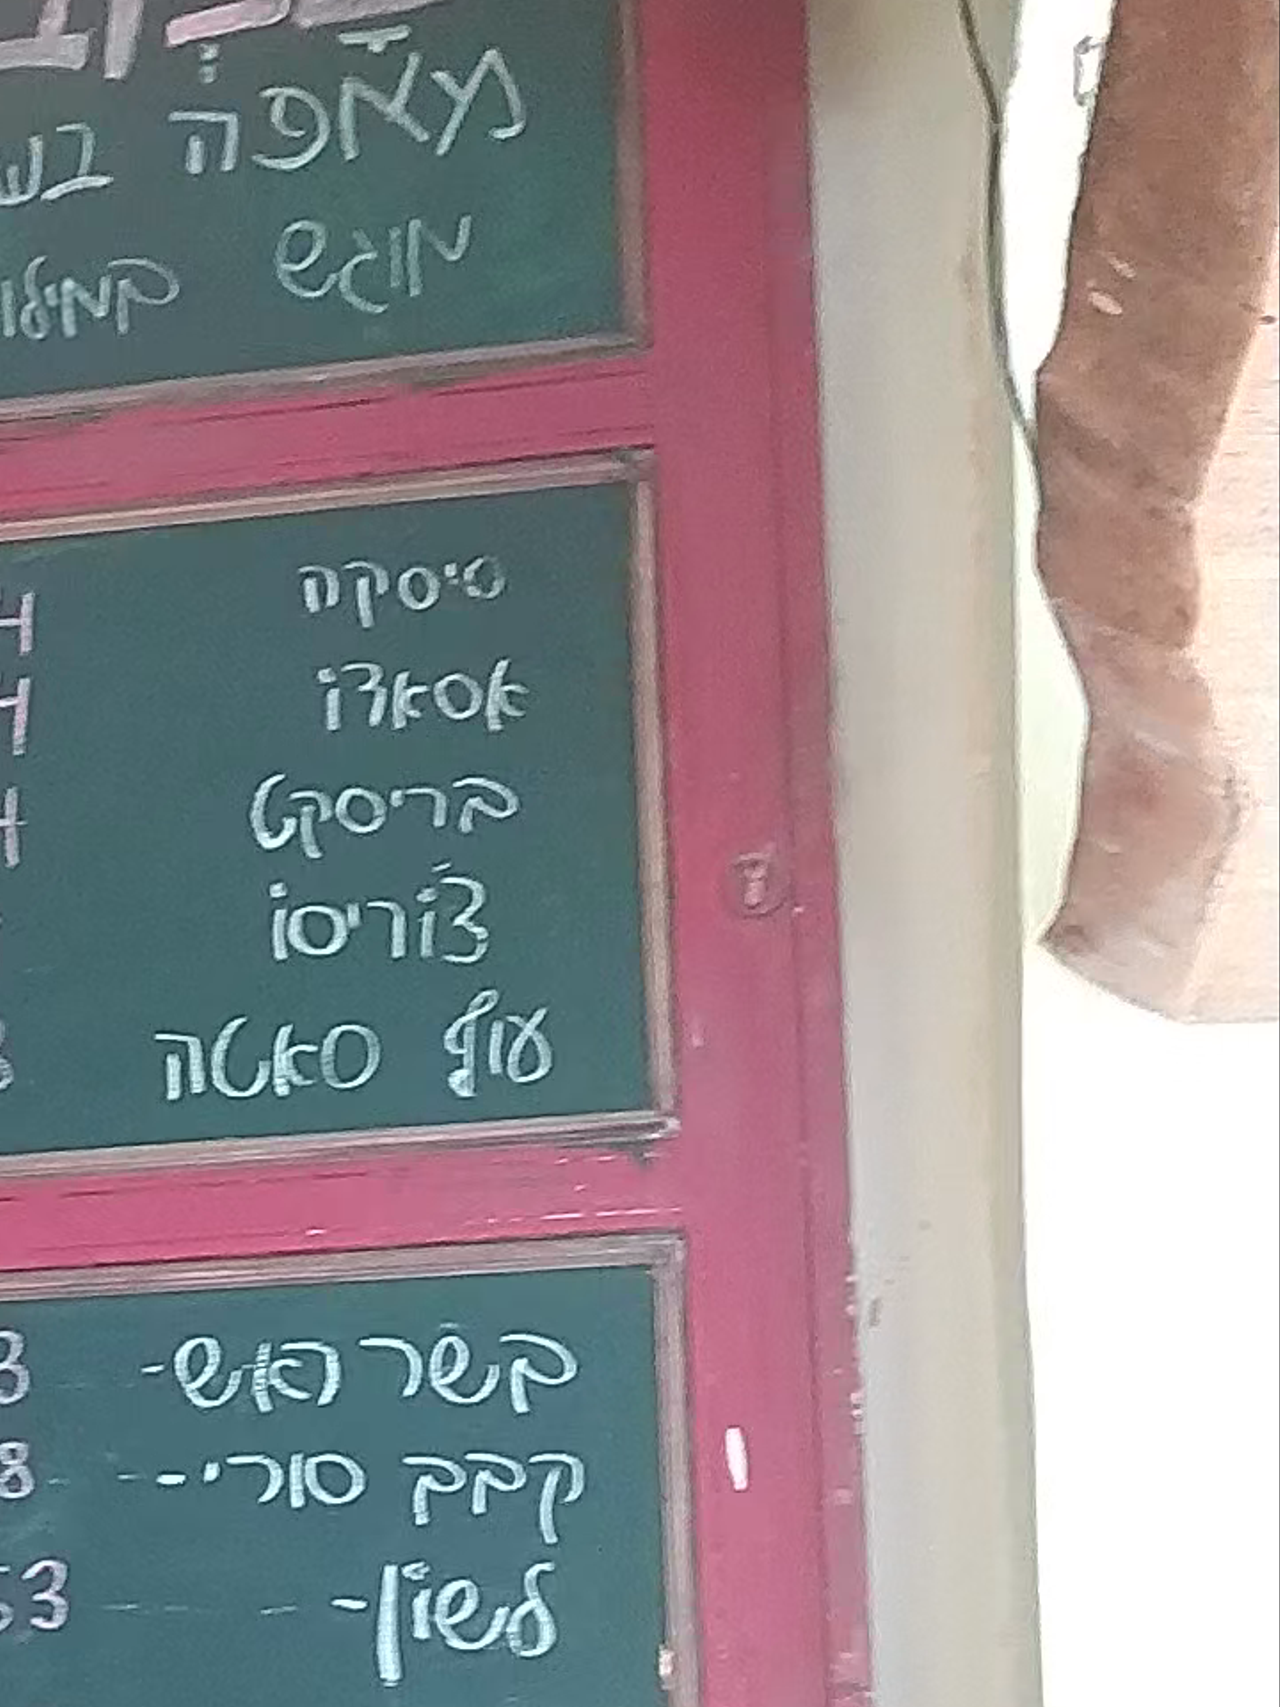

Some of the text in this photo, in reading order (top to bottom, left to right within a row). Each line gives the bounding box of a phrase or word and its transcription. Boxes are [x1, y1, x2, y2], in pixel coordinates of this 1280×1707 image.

[273, 215, 473, 314] מוגש
[297, 556, 509, 628] סיסקה
[248, 773, 521, 860] בריסקט
[153, 988, 554, 1101] עוף סאטה
[358, 1332, 580, 1415] בשר
[402, 1450, 586, 1545] קבב
